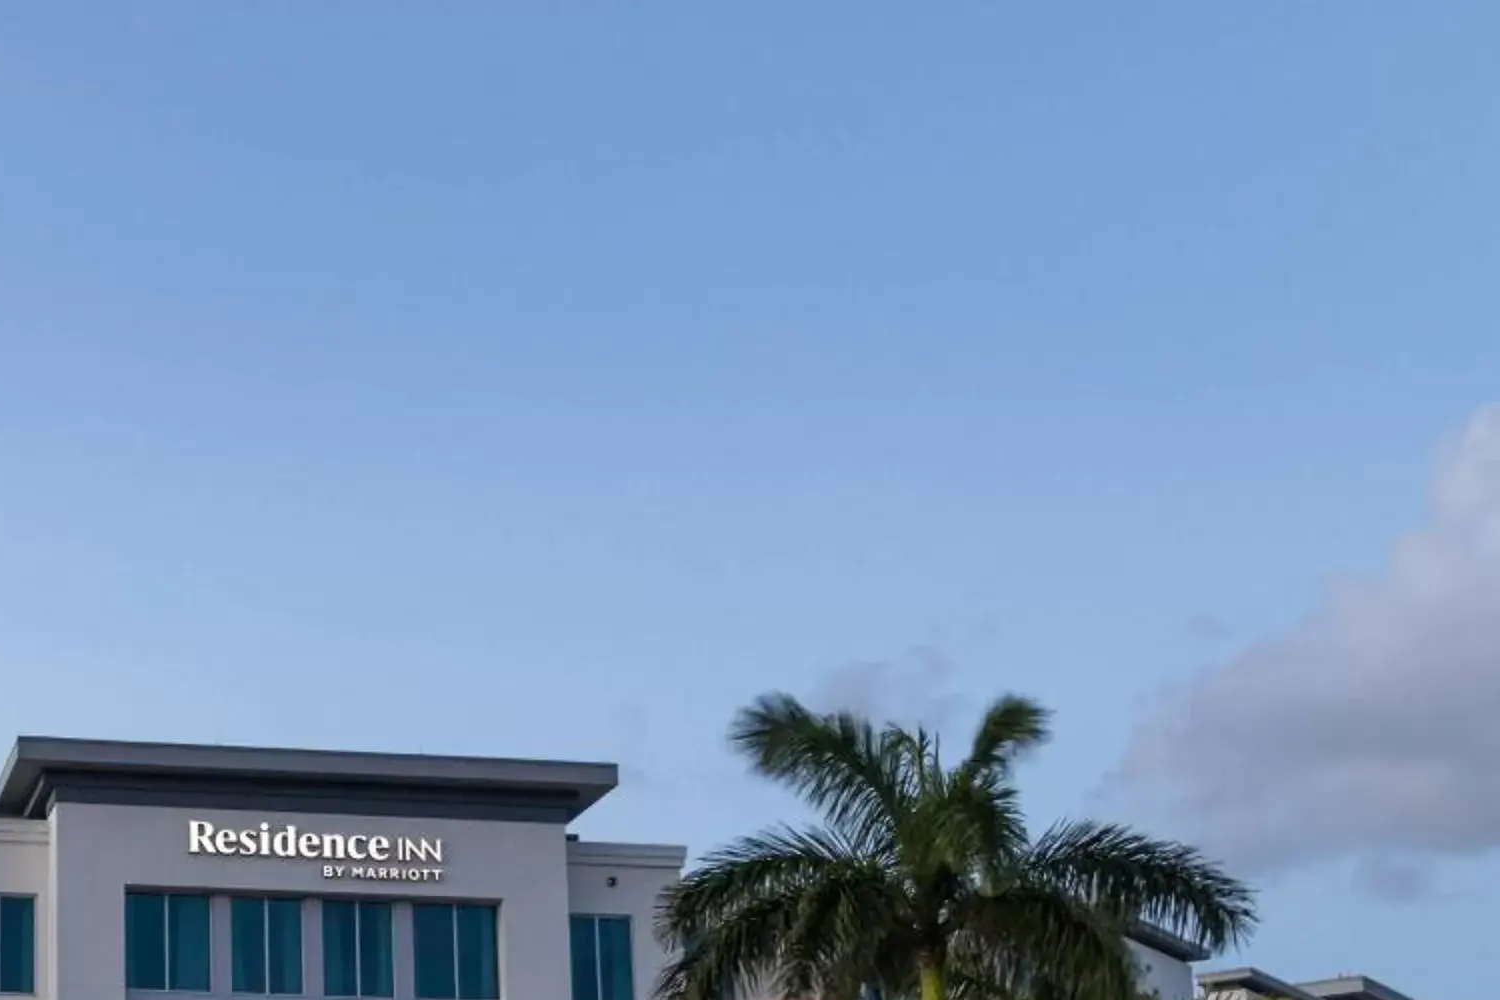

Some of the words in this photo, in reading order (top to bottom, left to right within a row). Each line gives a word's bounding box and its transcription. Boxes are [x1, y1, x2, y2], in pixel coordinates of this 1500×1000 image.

[188, 820, 390, 861] Residence
[398, 836, 443, 862] INN
[323, 865, 345, 878] BY
[351, 866, 443, 881] MARRIOTT
